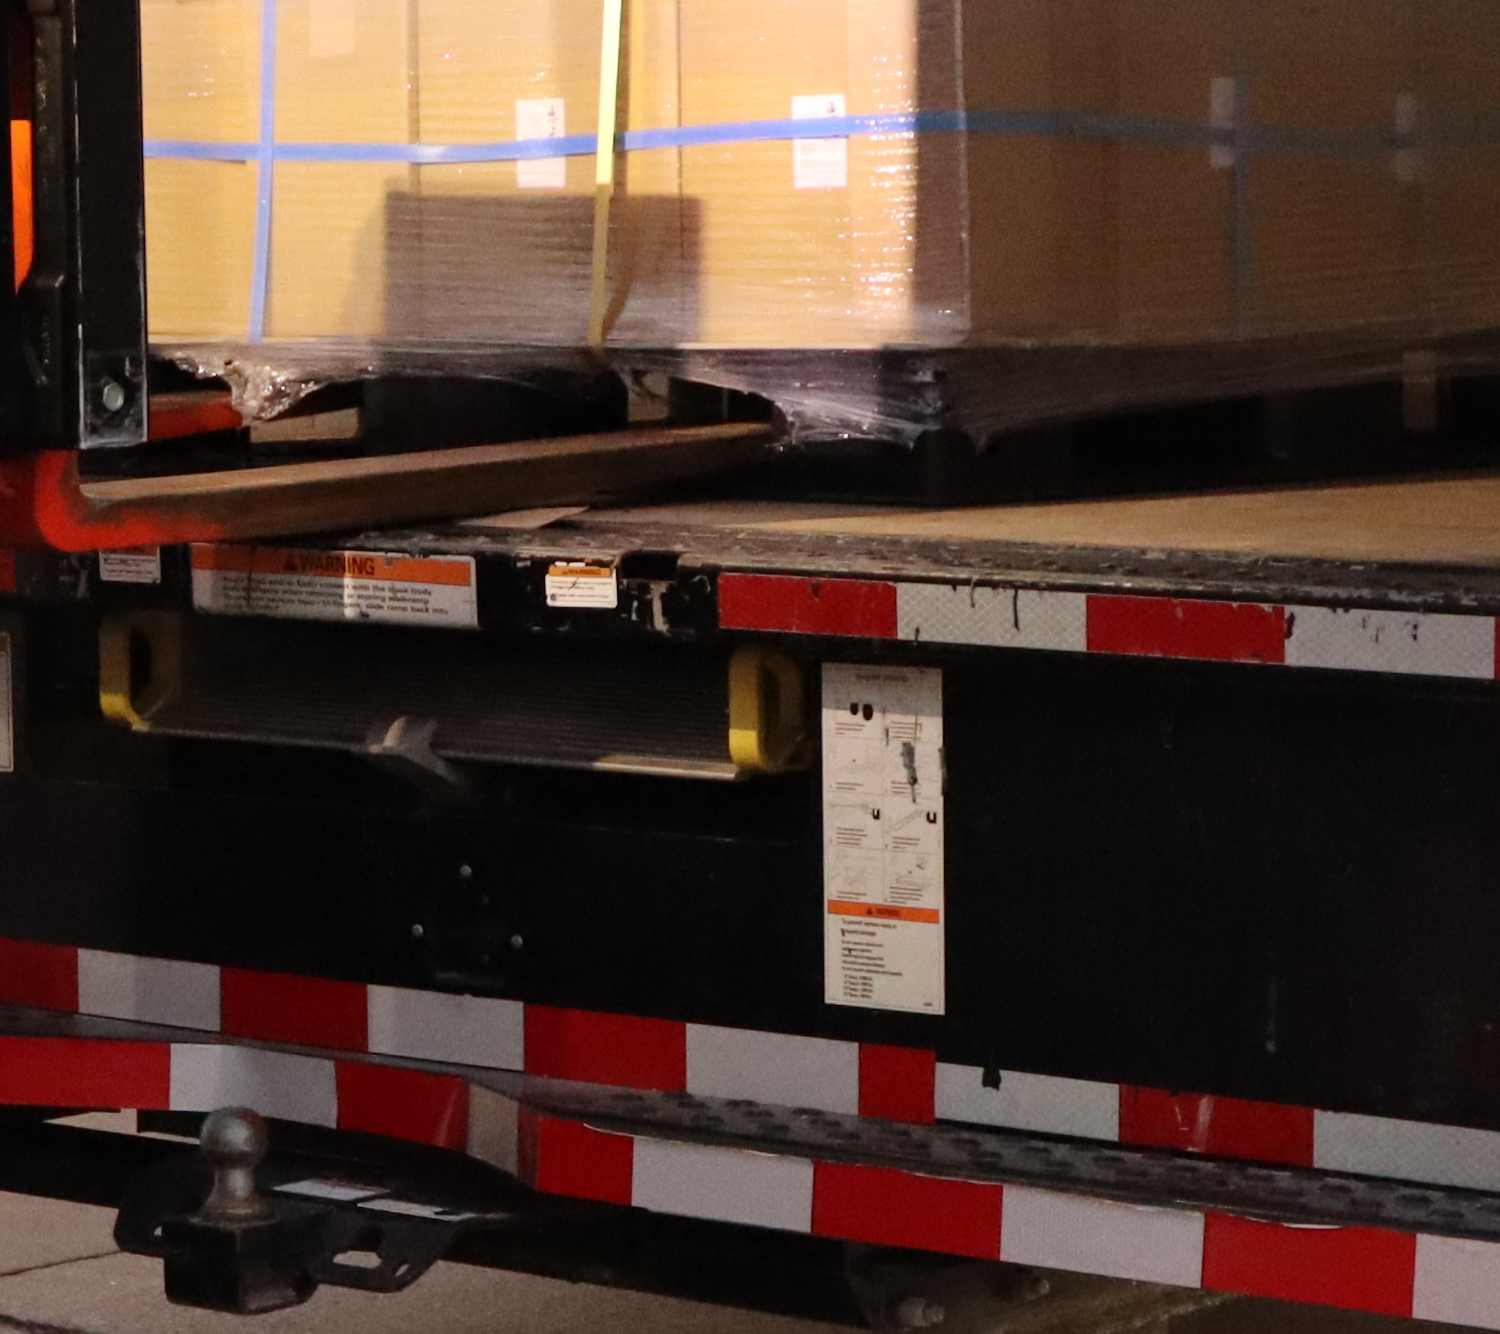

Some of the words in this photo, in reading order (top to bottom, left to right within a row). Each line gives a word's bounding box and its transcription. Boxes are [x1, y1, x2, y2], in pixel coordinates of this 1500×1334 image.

[298, 555, 375, 576] WARNING
[411, 586, 432, 597] body
[356, 592, 386, 603] storing
[366, 602, 385, 611] slide
[411, 605, 430, 614] back
